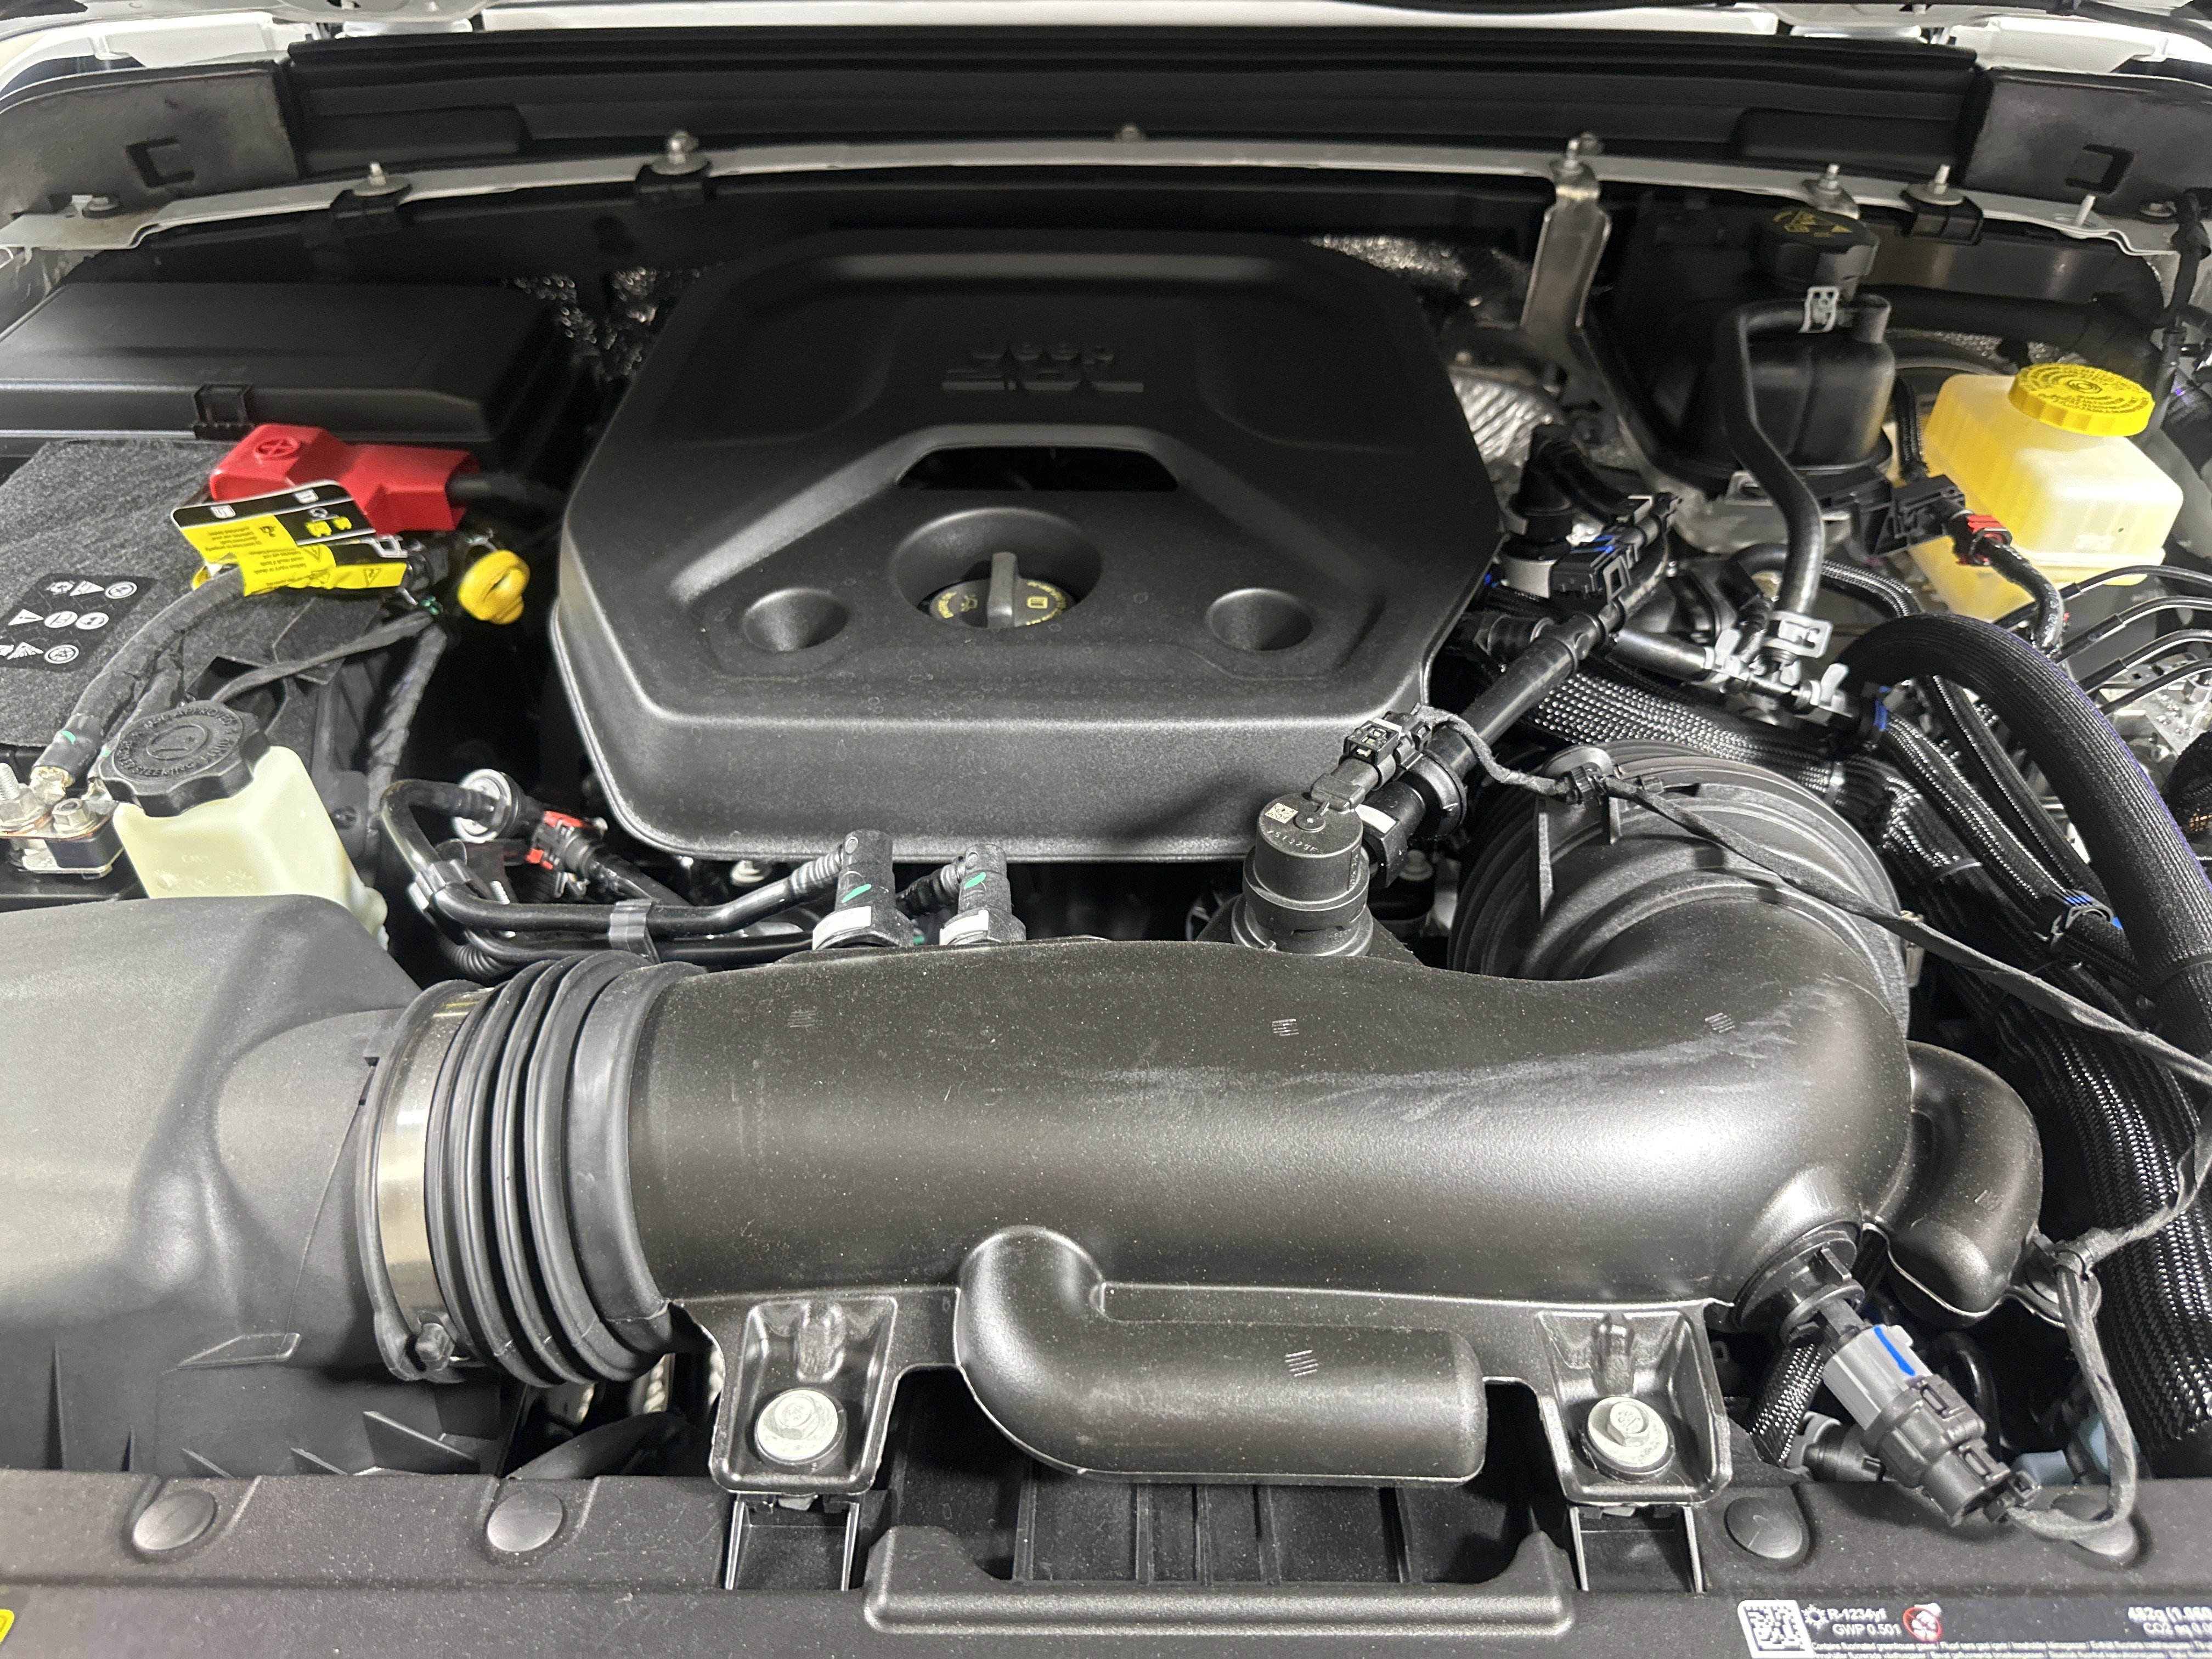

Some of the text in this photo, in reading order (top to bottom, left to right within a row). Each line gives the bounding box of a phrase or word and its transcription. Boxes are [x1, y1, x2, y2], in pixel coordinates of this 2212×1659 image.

[132, 761, 196, 777] STEERING
[1827, 1608, 1887, 1622] R-1234yf
[1832, 1623, 1902, 1636] GWP 0.501
[2143, 1622, 2174, 1637] CO2
